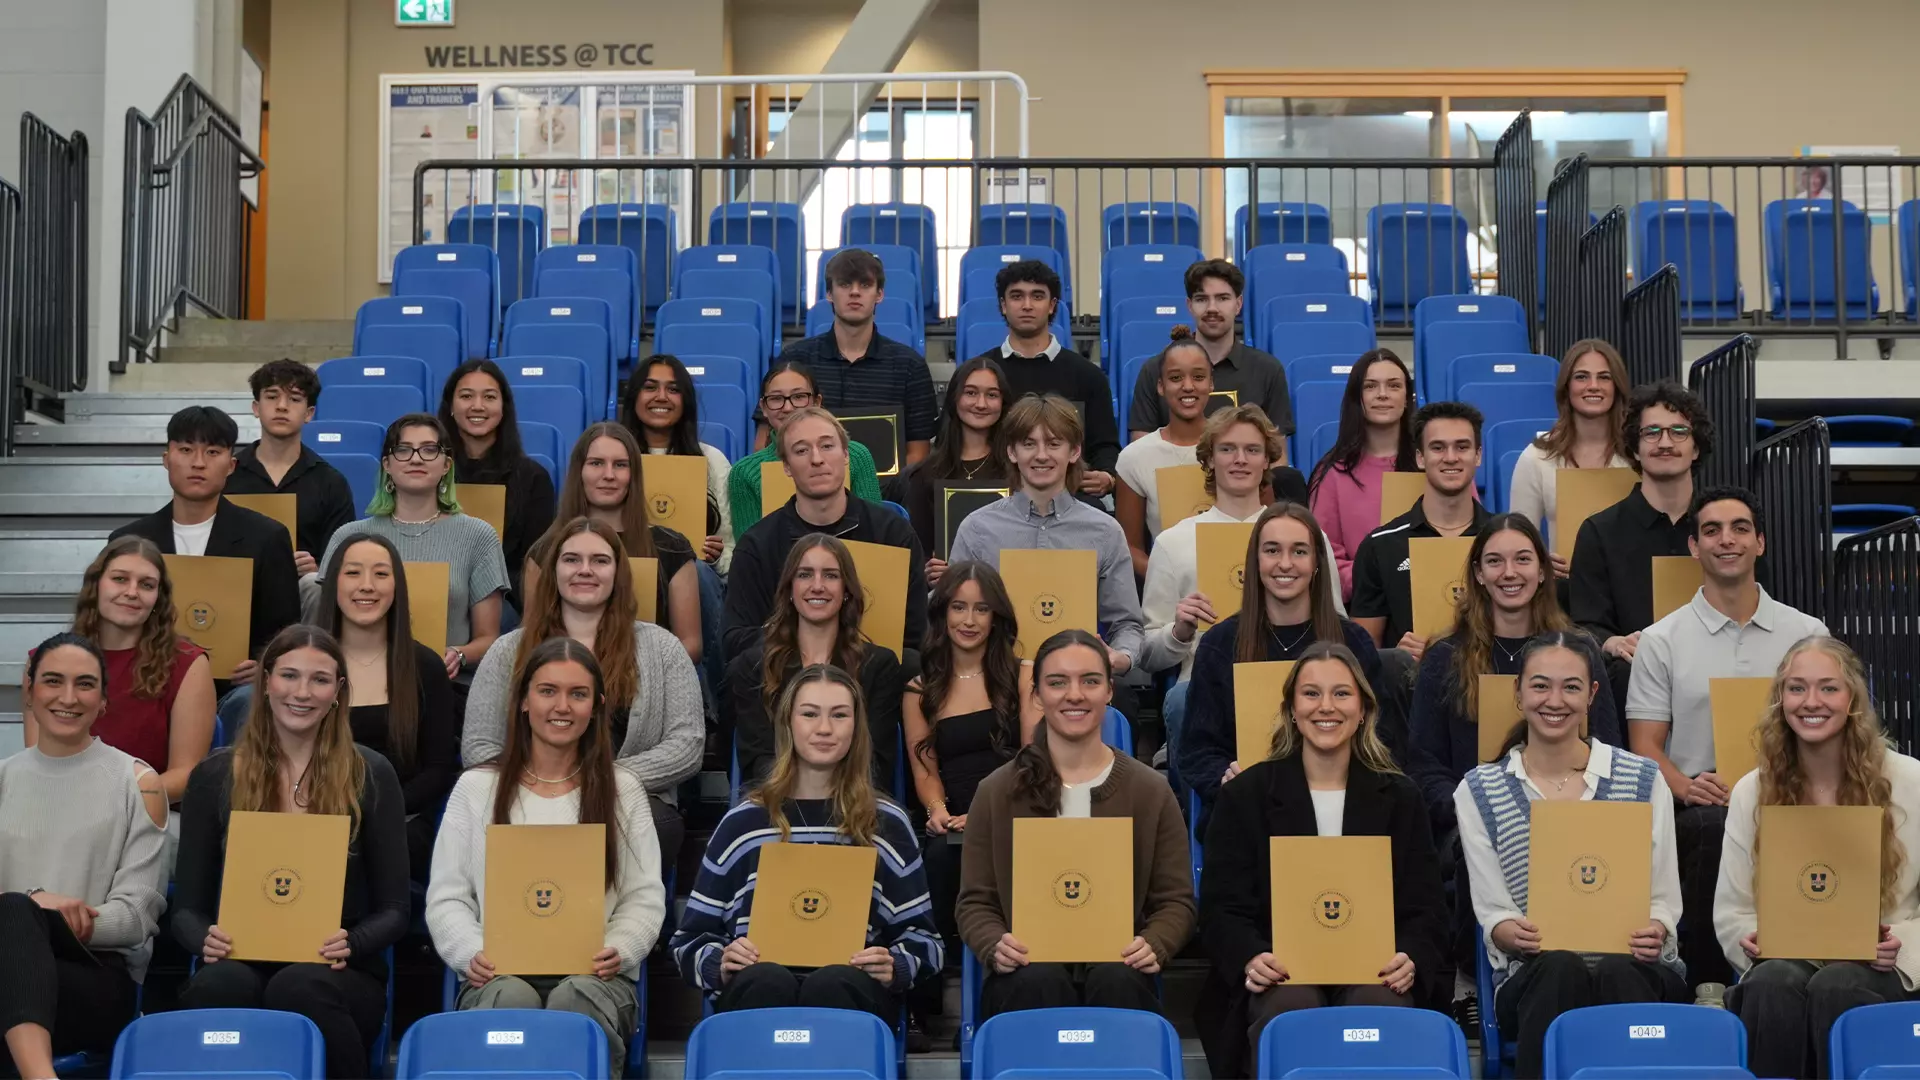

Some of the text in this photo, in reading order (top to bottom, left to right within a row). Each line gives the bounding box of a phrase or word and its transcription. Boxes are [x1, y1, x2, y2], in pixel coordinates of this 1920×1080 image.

[424, 43, 654, 68] WELLNESS @ TCC
[407, 94, 464, 105] AND TRAINERS
[781, 1031, 802, 1042] 038
[1066, 1031, 1087, 1041] 039
[1351, 1029, 1371, 1040] 034
[1637, 1026, 1658, 1037] 040
[211, 1032, 232, 1043] 035
